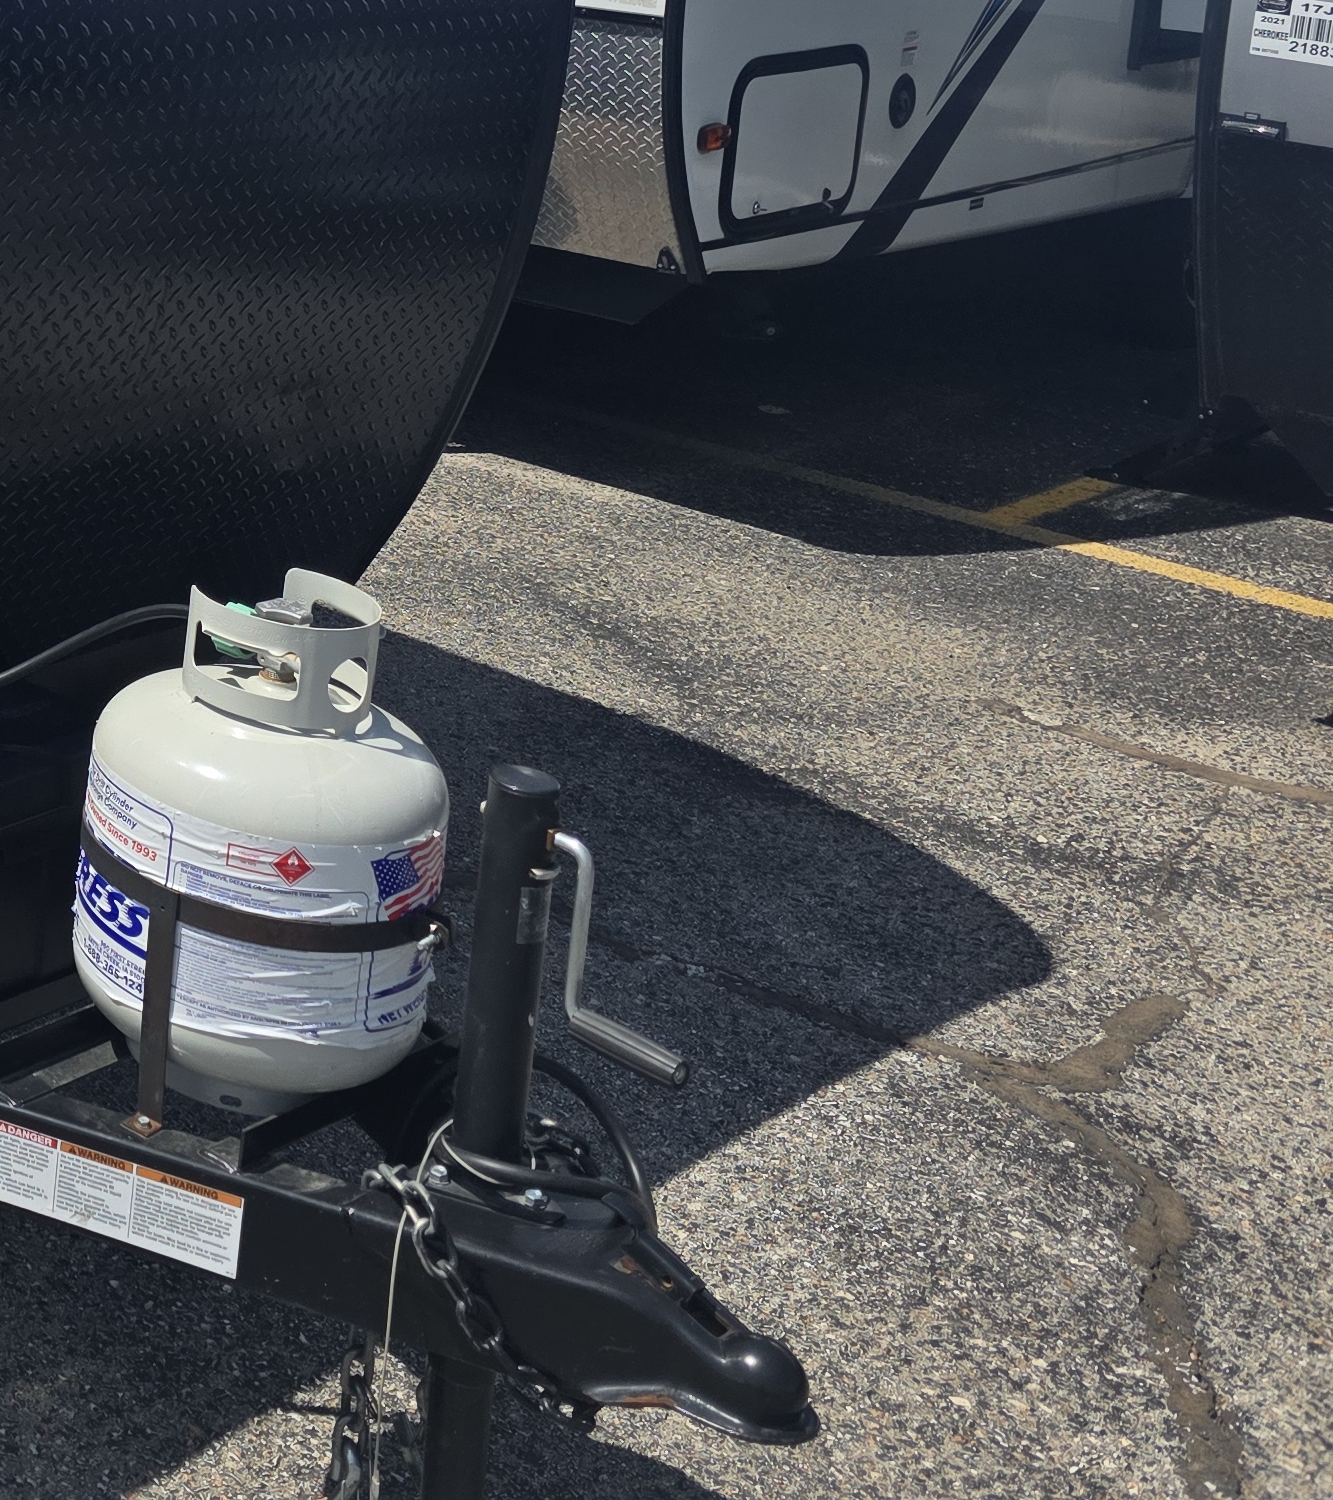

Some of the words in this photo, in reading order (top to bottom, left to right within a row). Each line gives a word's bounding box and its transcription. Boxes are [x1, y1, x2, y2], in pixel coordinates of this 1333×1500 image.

[1261, 16, 1286, 25] 2021
[1254, 28, 1289, 41] CHEROKEE
[104, 785, 134, 813] Cylinder
[104, 796, 137, 830] Company
[107, 822, 129, 846] Since
[131, 840, 157, 862] 1993
[7, 1125, 53, 1147] DANGER
[76, 1148, 126, 1171] WARNING
[168, 1176, 219, 1201] WARNING
